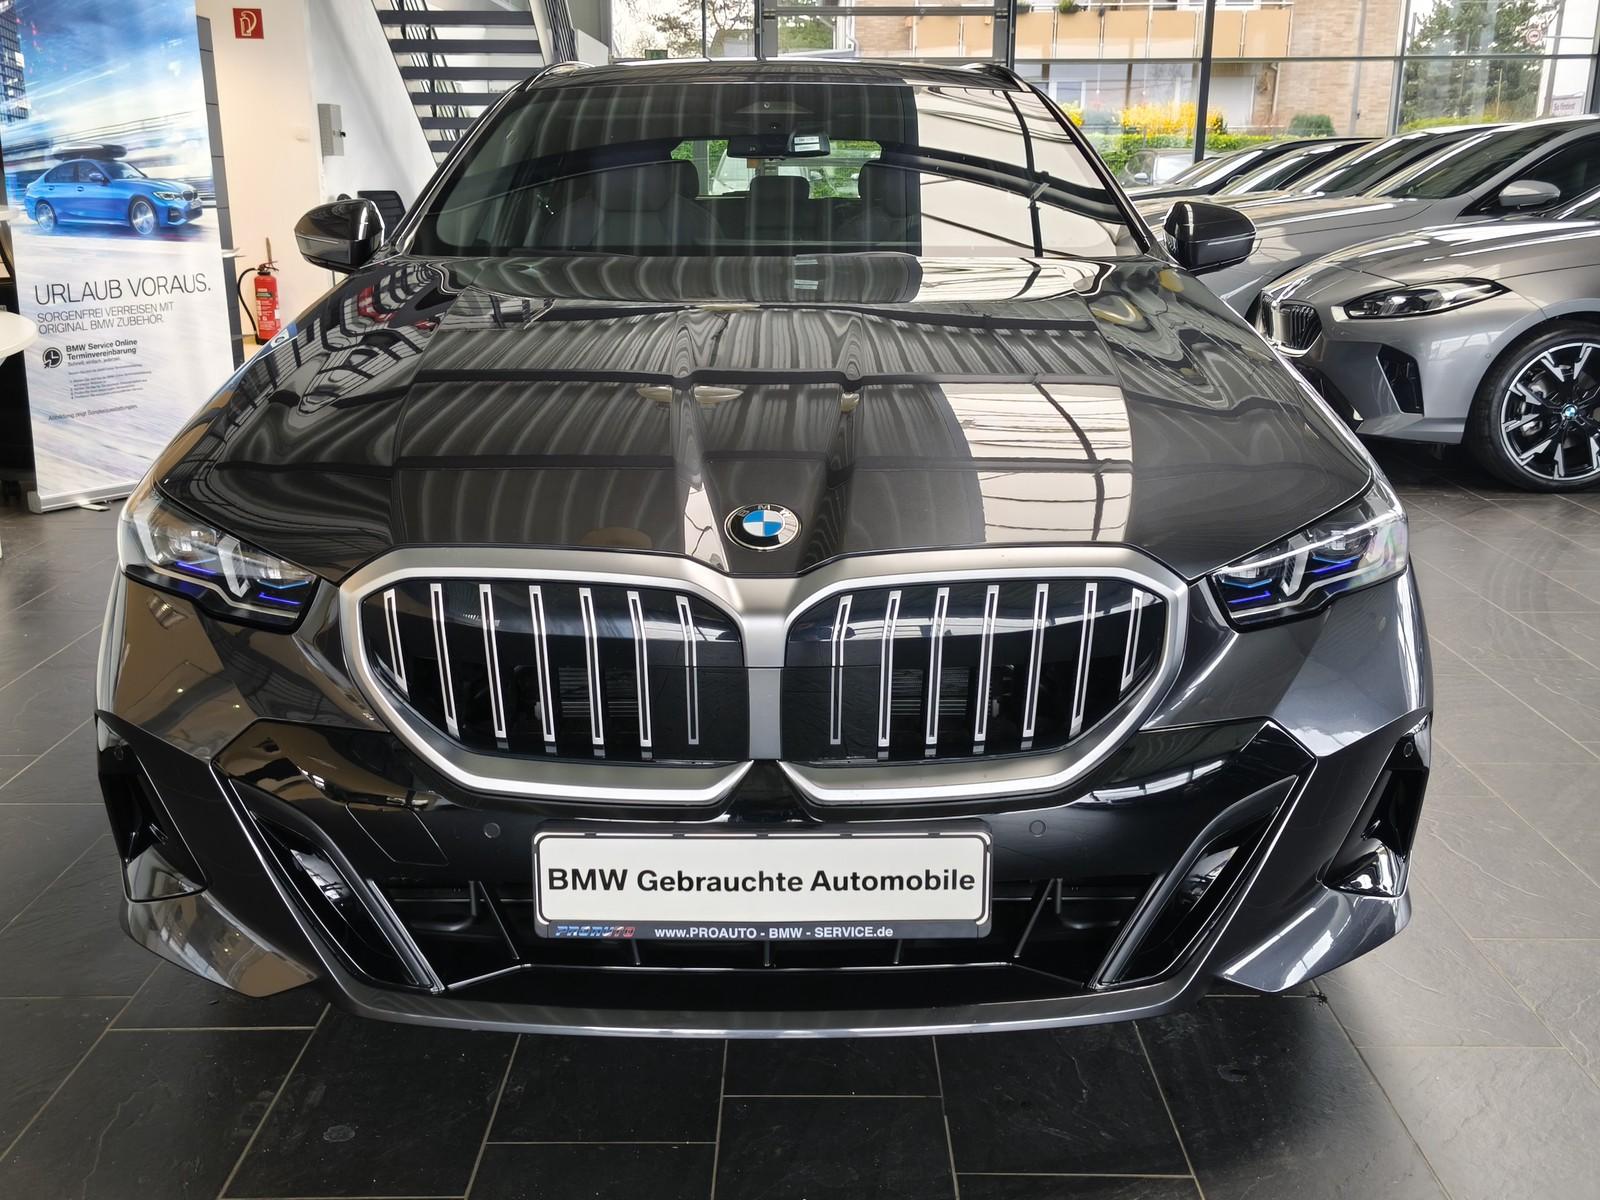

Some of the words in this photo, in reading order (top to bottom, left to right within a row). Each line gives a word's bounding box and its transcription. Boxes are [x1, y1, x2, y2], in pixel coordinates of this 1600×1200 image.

[35, 280, 123, 305] URLAUB
[127, 273, 211, 297] VORAUS.
[37, 308, 103, 324] SORGENFREI
[106, 304, 158, 317] VERREISEN
[159, 301, 174, 312] MIT
[38, 323, 88, 335] ORIGINAL
[90, 319, 115, 330] BMW
[65, 344, 86, 352] BMW
[88, 342, 114, 350] Service
[115, 339, 138, 347] Online
[66, 347, 137, 361] Terminvereinbarung
[549, 868, 628, 891] BMW
[636, 869, 803, 892] Gebrauchte
[810, 869, 976, 892] Automobile
[654, 927, 757, 939] www.PROAUTO
[768, 927, 803, 939] BMW
[814, 926, 894, 938] SERVICE.de
